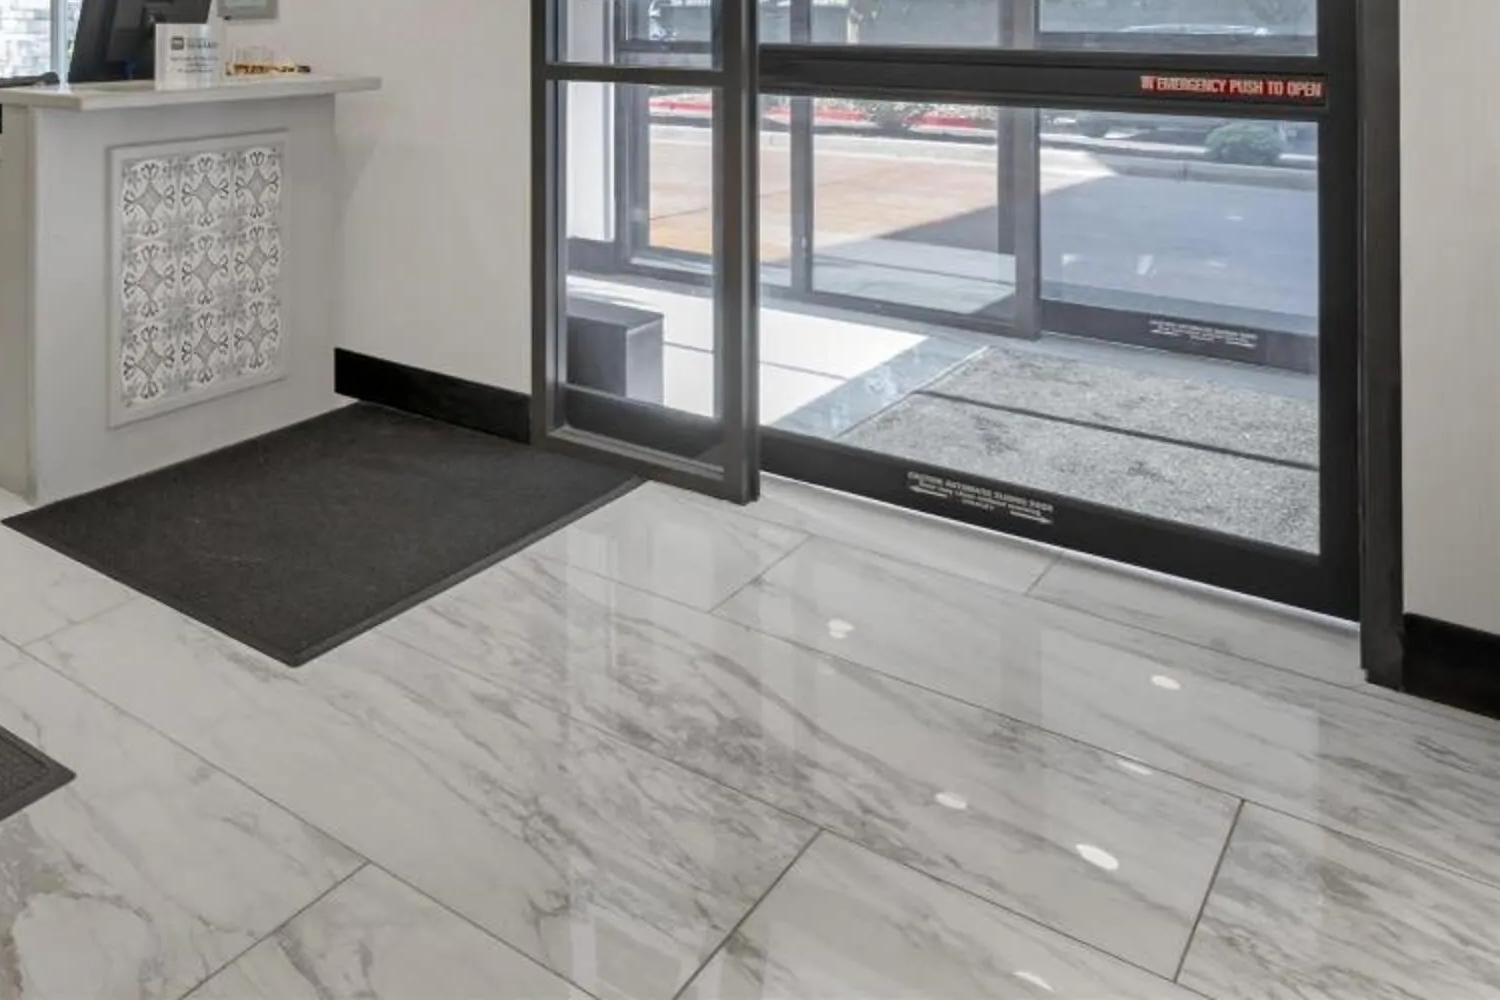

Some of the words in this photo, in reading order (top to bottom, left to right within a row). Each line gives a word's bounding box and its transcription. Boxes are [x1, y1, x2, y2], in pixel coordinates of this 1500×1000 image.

[1139, 75, 1155, 90] IN
[1157, 77, 1227, 93] EMERGENCY
[1229, 79, 1264, 95] PUSH
[1266, 81, 1284, 95] TO
[1286, 81, 1323, 97] OPEN
